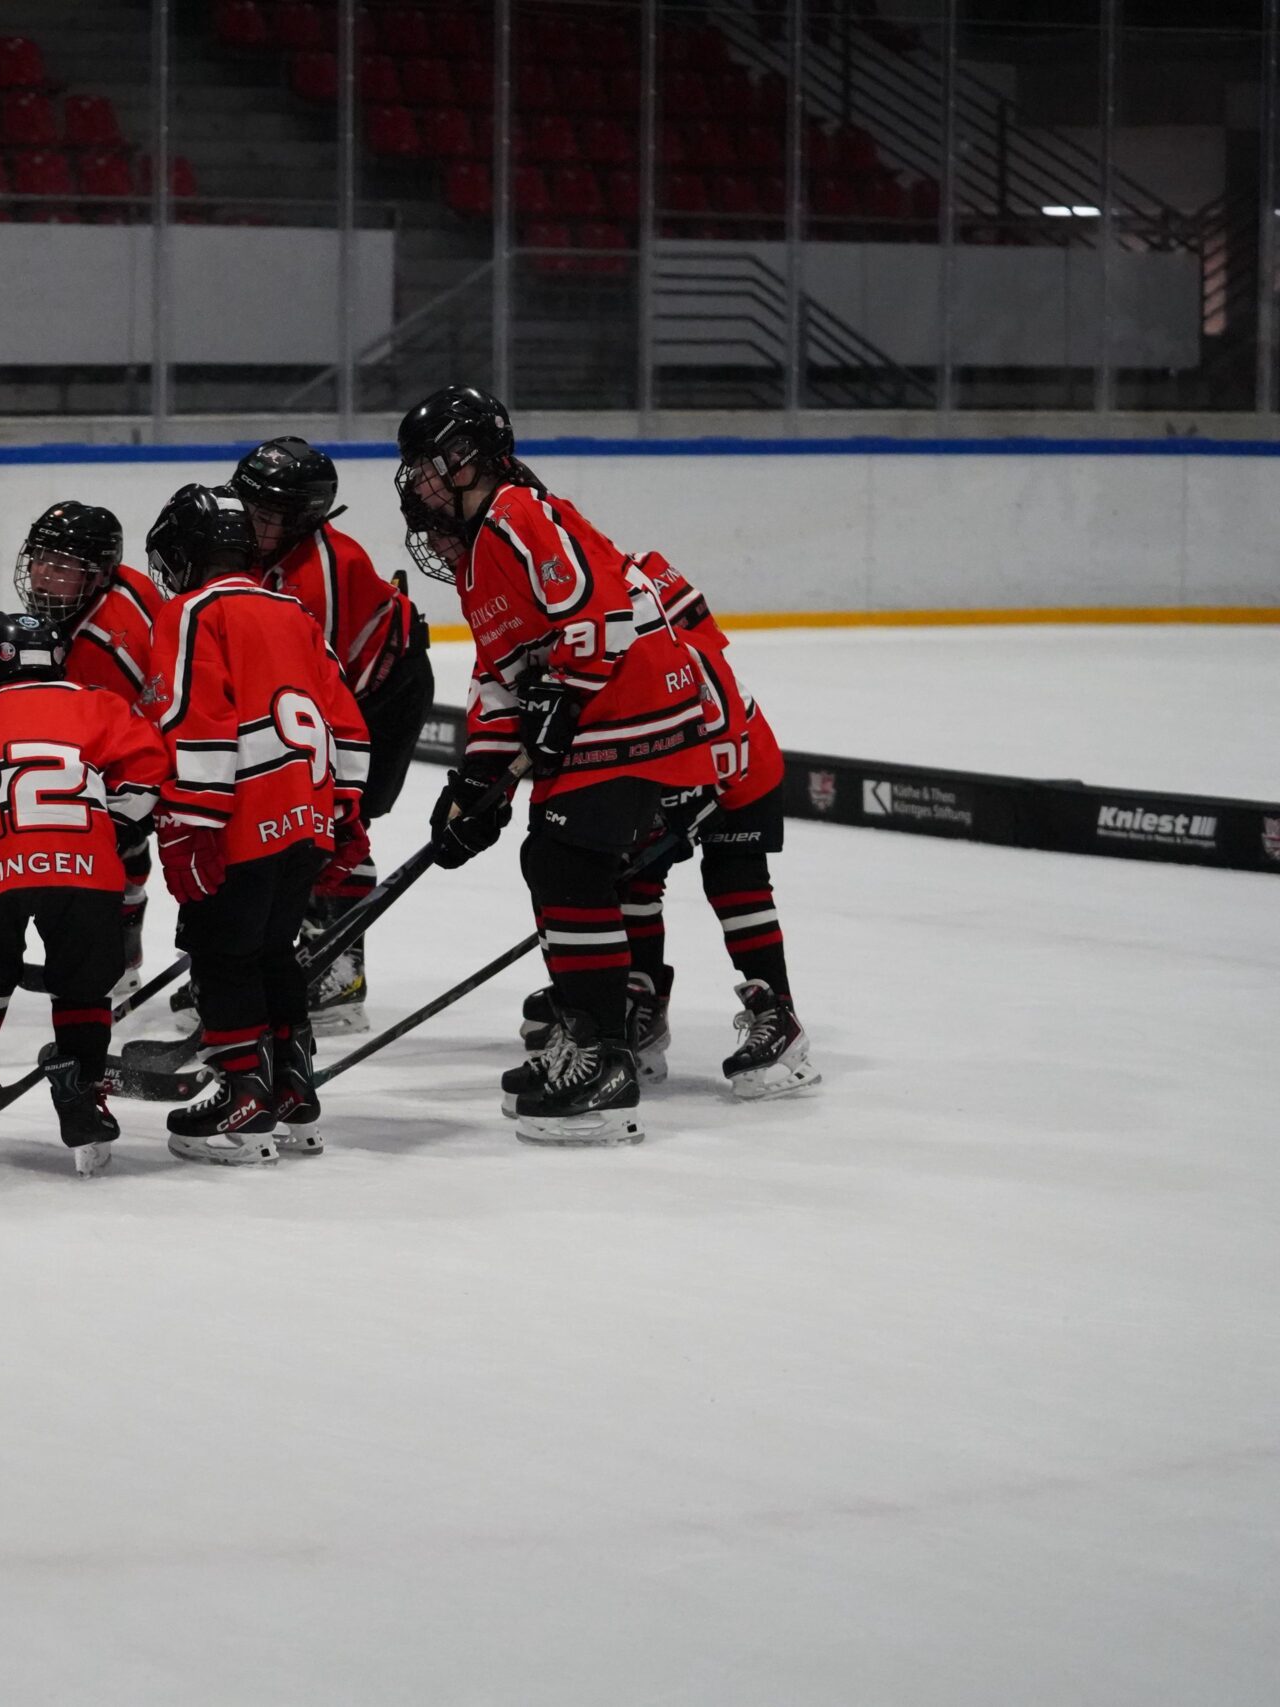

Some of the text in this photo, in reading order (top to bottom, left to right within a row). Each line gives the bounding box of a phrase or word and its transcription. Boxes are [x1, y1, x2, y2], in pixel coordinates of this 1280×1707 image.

[275, 690, 329, 786] 9
[1097, 805, 1190, 836] Kniest
[702, 831, 762, 843] AUER
[216, 1098, 257, 1132] CCM
